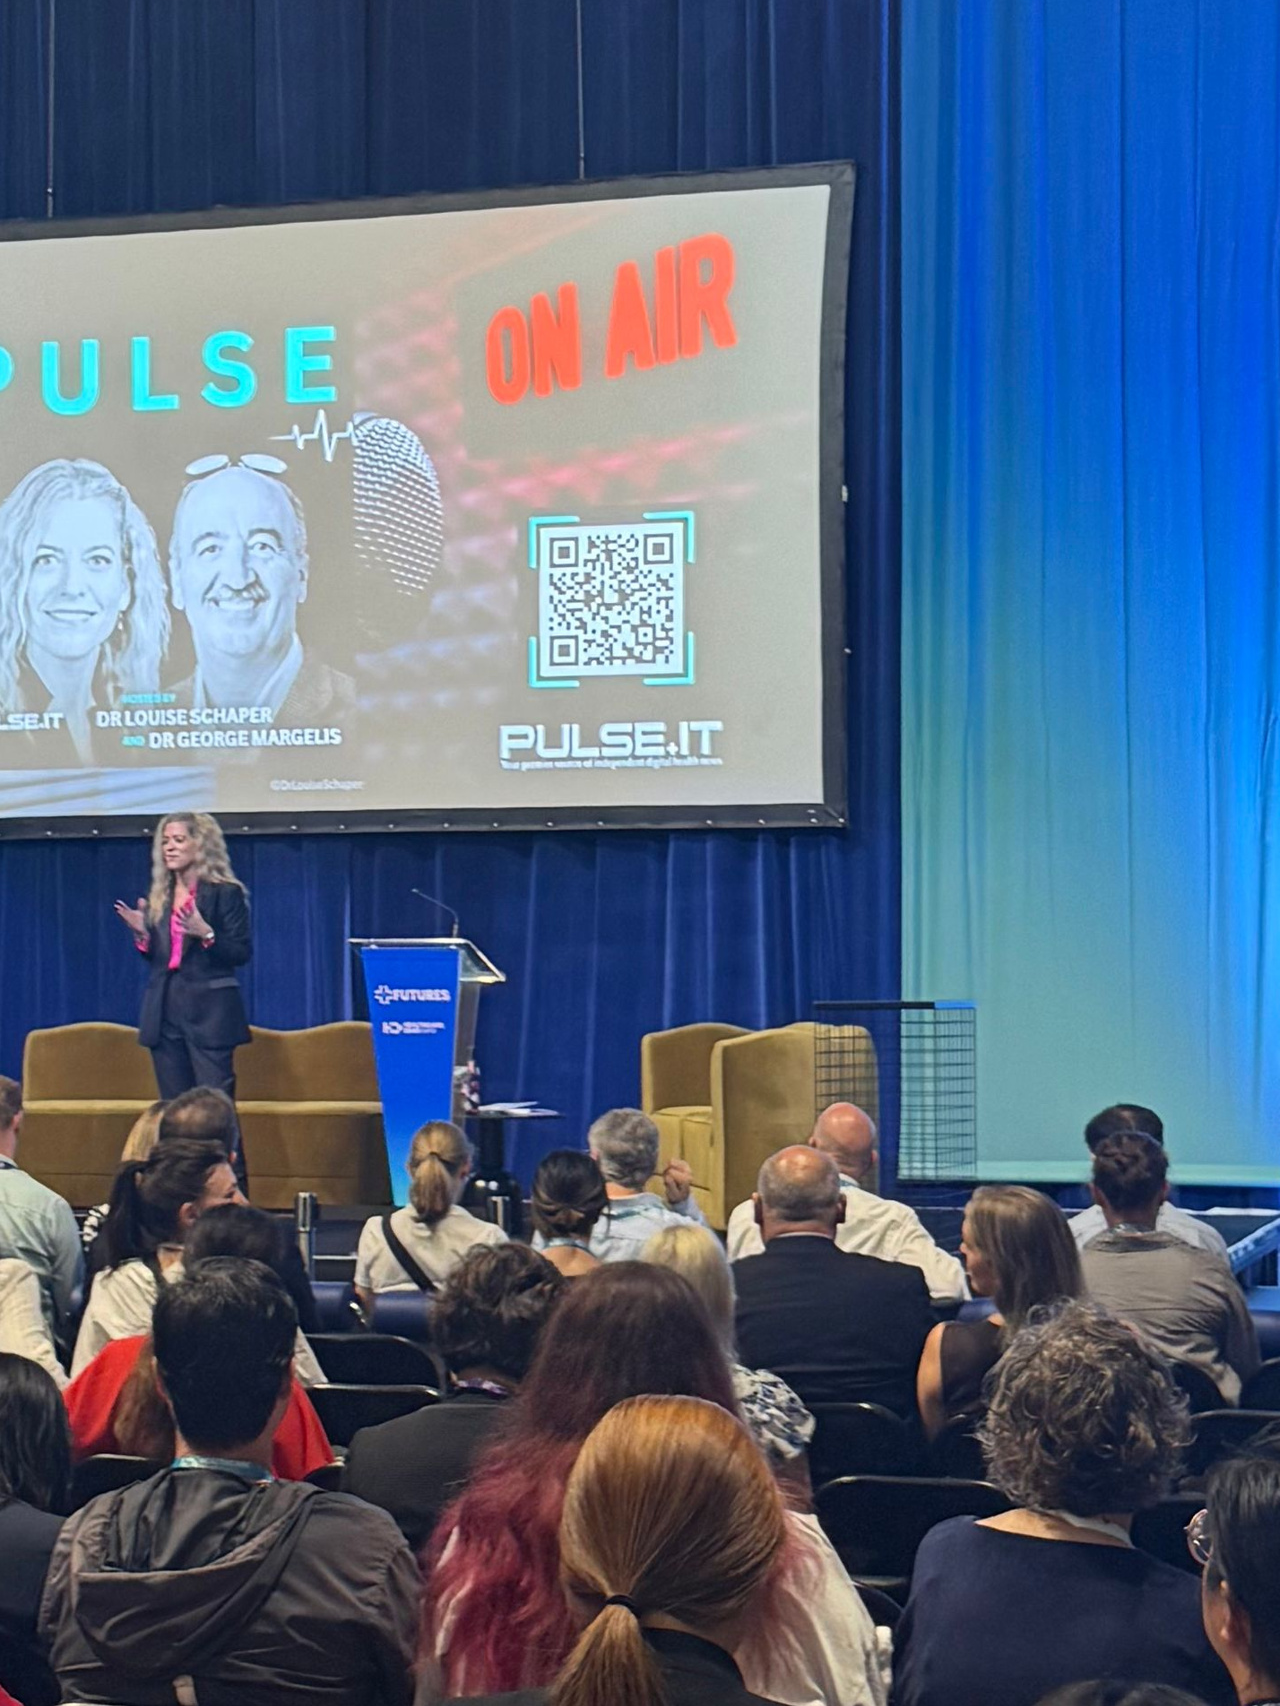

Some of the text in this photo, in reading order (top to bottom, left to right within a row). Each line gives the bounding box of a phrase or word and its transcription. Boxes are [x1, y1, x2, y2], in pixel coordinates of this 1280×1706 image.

[485, 231, 738, 405] ON AIR
[95, 706, 274, 728] DR LOUISE SCHAPER
[149, 732, 175, 749] DR
[177, 730, 249, 748] GEORGE
[251, 727, 342, 746] MARGELIS
[392, 989, 451, 1002] FUTURES
